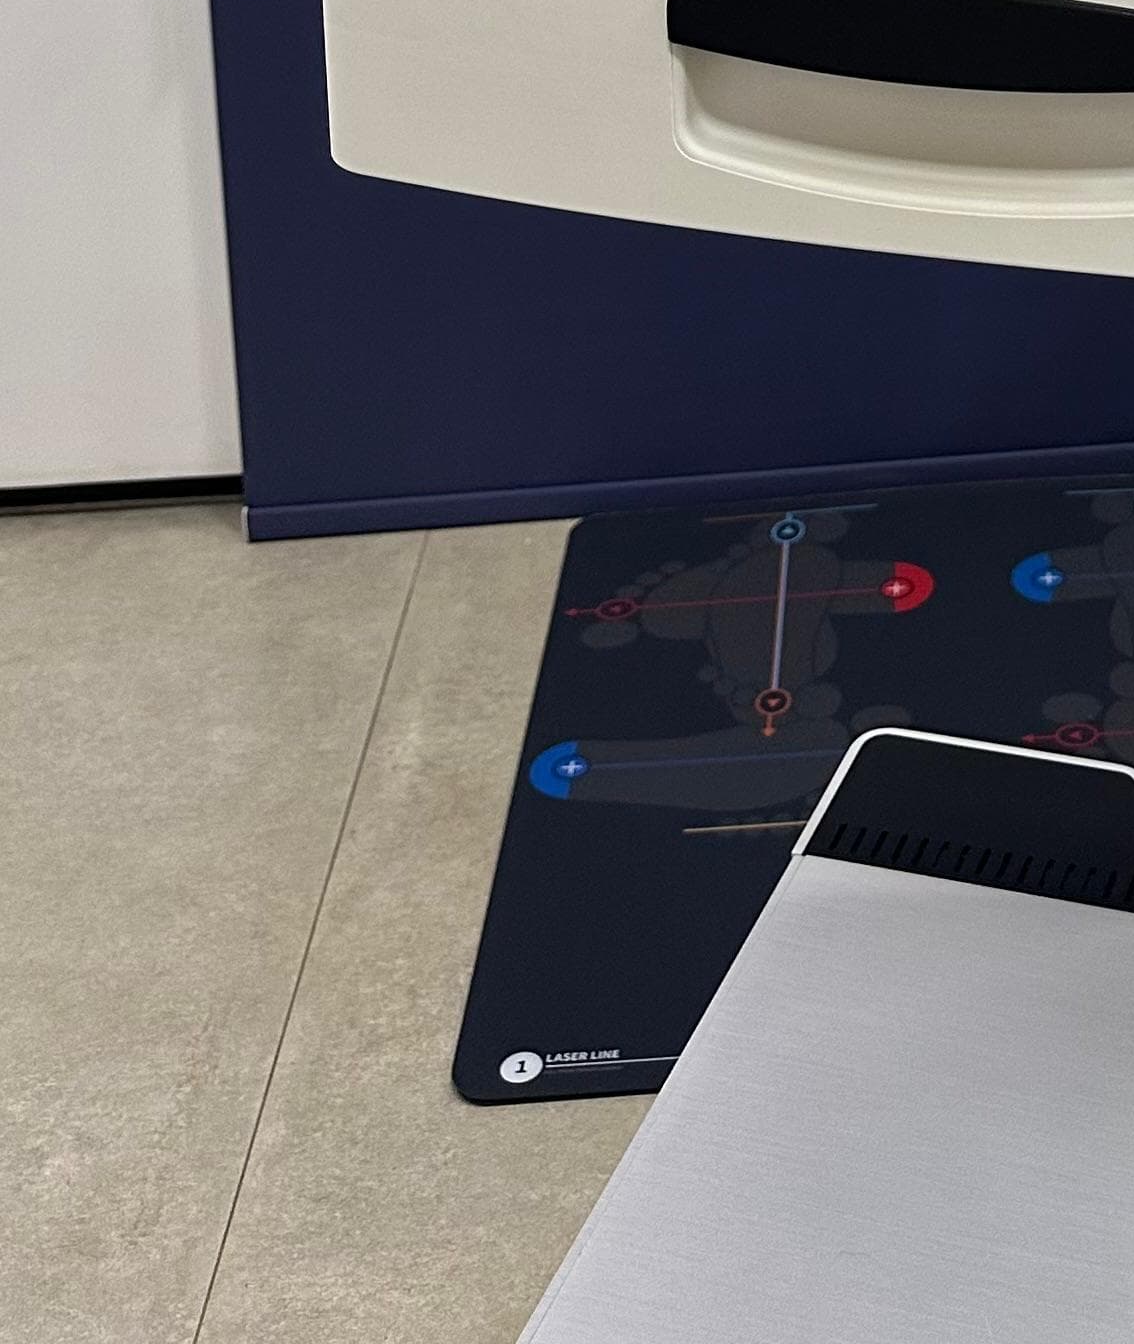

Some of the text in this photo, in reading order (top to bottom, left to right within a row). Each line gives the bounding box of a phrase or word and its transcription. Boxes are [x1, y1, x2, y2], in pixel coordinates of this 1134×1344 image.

[514, 1049, 620, 1074] 1 LASER LINE
